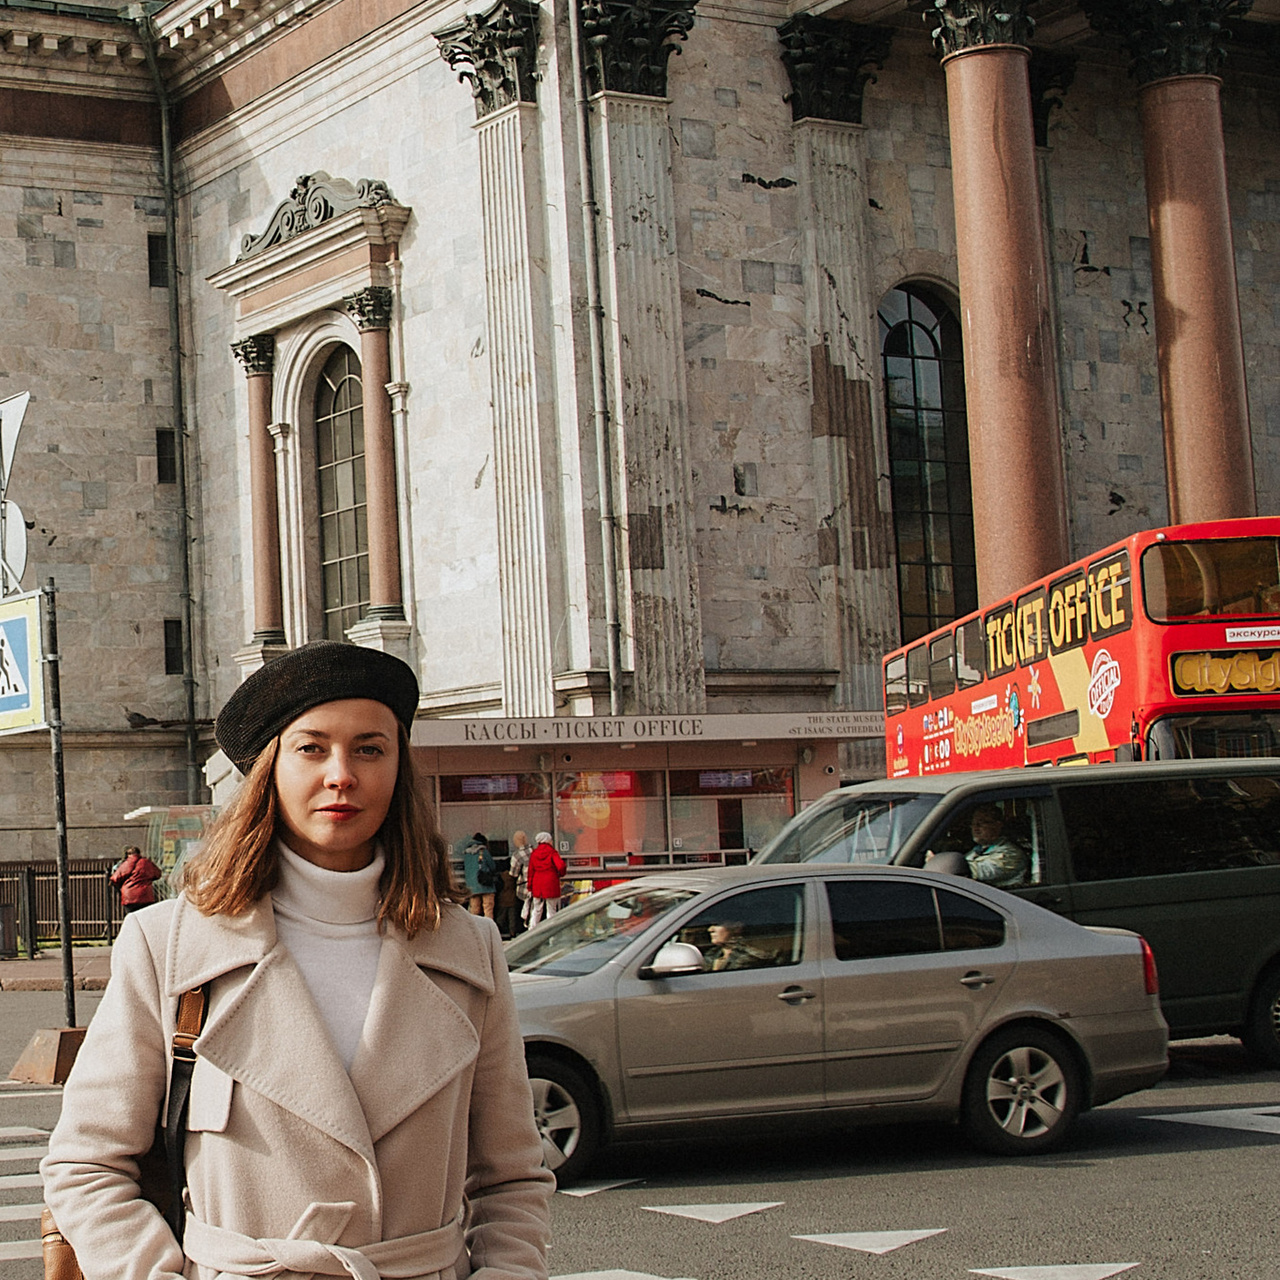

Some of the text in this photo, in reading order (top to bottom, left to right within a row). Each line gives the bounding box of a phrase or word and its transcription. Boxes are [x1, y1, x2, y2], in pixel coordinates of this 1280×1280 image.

[986, 562, 1125, 672] TICKET OFFICE
[1091, 666, 1119, 705] OFFICIAL
[464, 719, 703, 741] КАССЫ TICKET OFFICE
[807, 716, 824, 724] THE
[826, 715, 851, 723] STATE
